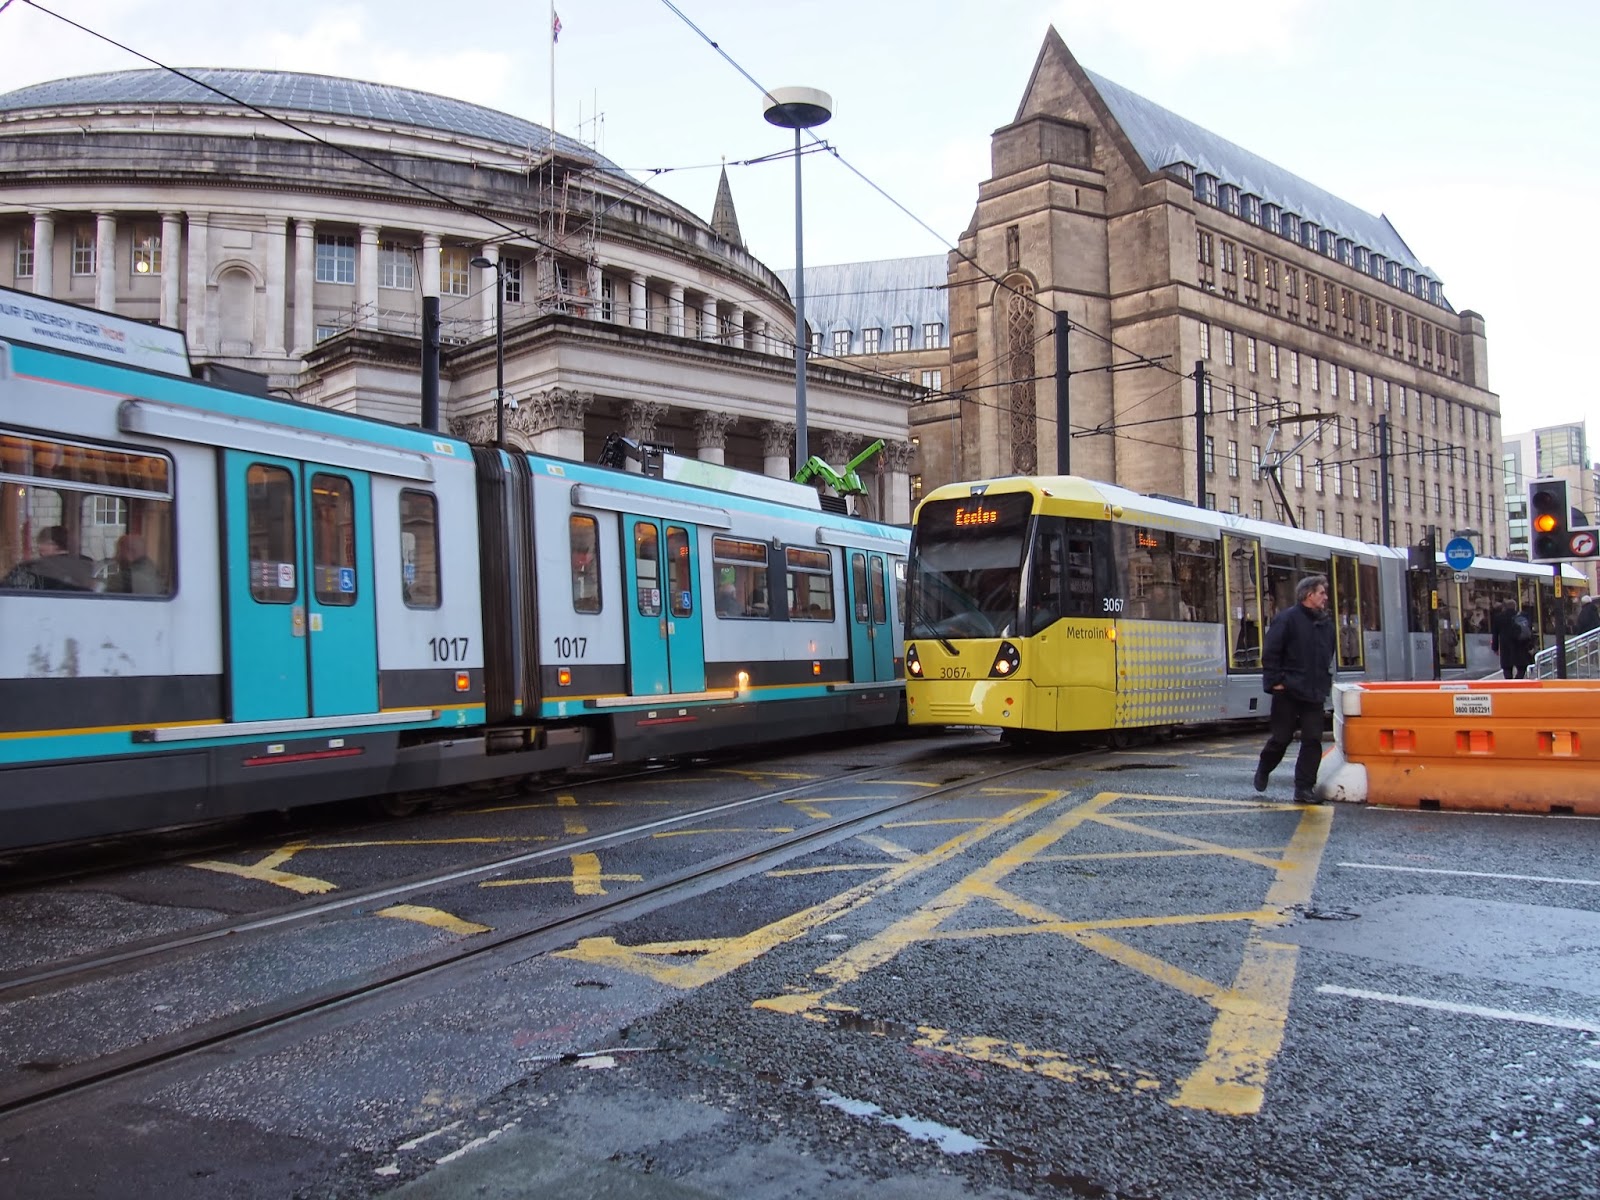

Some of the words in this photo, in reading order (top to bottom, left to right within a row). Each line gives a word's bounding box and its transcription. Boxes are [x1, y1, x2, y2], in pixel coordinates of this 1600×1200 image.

[23, 309, 73, 330] ENERGY
[76, 321, 100, 336] FOR
[956, 507, 997, 526] Eccles
[1455, 573, 1468, 581] Only
[1103, 598, 1124, 612] 3067
[1067, 626, 1110, 639] Metrolink
[428, 637, 469, 662] 1017
[554, 636, 587, 658] 1017
